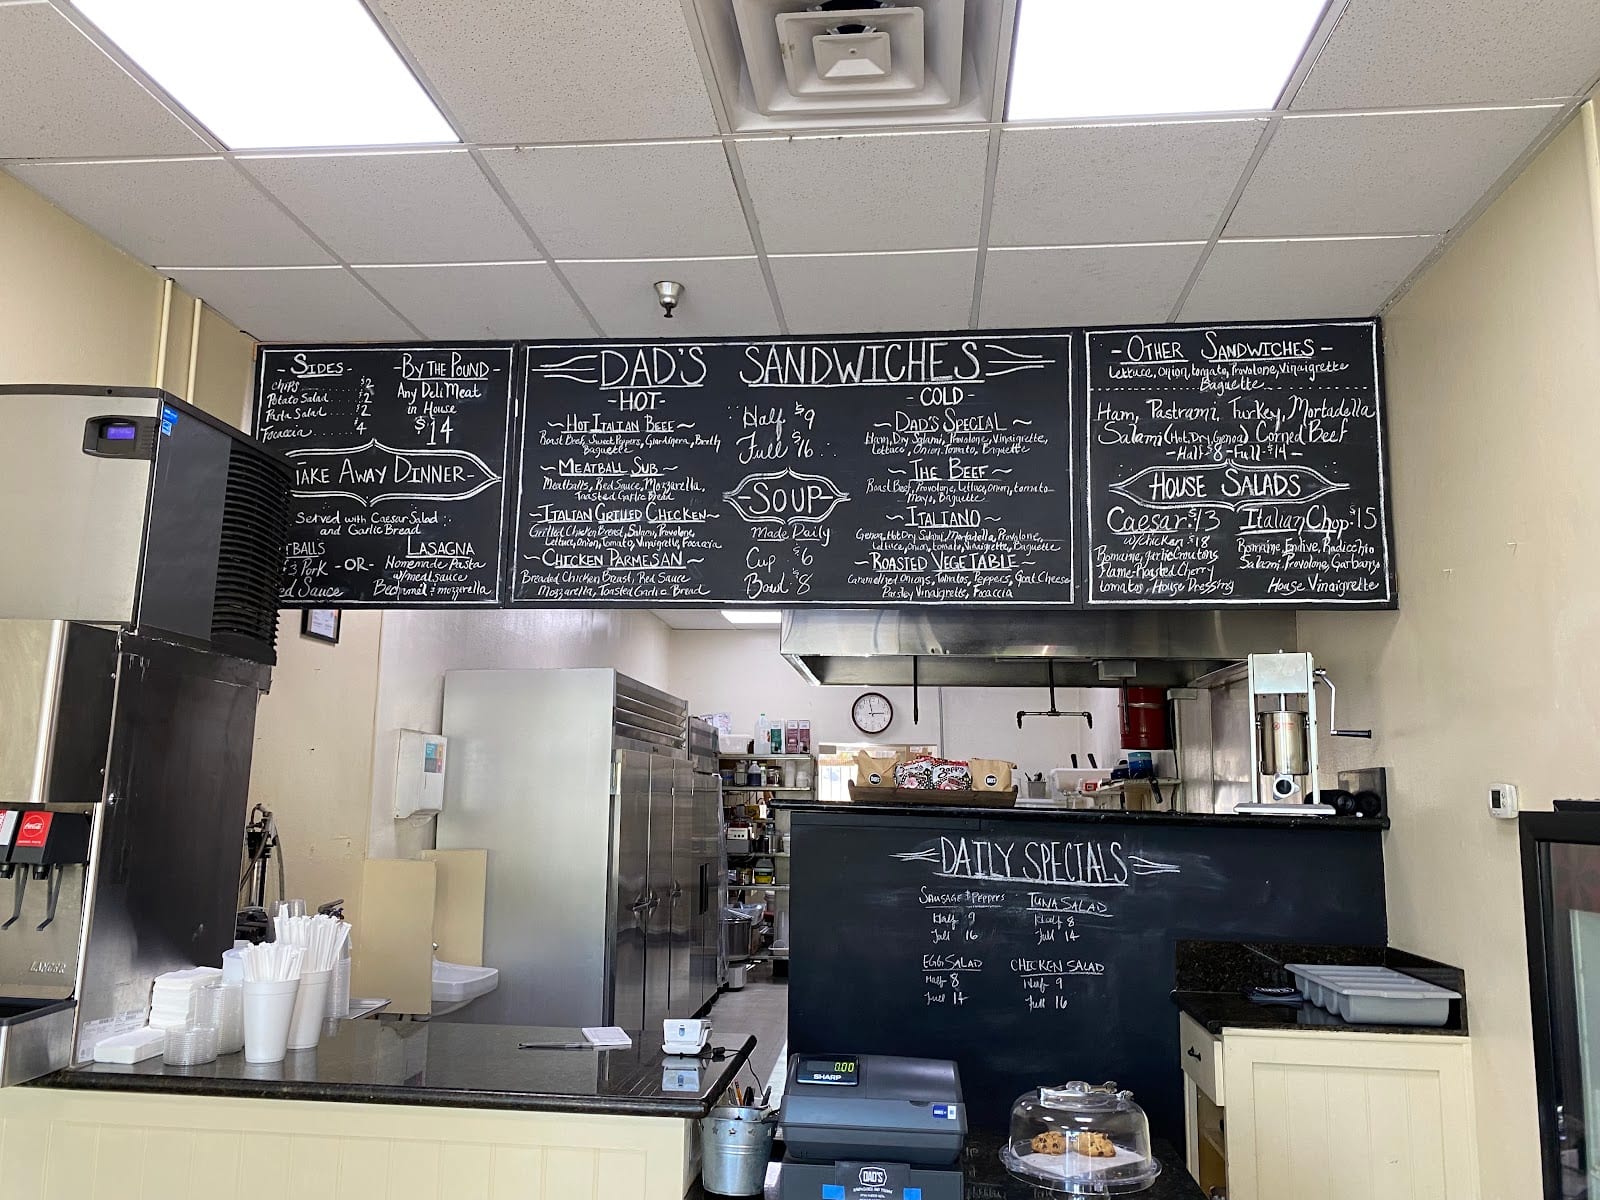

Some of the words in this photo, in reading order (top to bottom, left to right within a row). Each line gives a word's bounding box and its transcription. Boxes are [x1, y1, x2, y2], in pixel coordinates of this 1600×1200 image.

[1127, 335, 1184, 361] OTHER
[1201, 331, 1315, 360] SANDWICHES
[290, 353, 344, 376] SIDES
[427, 360, 447, 377] THE
[451, 351, 489, 377] POUND
[600, 347, 707, 387] DAD'S
[739, 341, 981, 384] SANDWICHES
[360, 376, 374, 390] $2
[397, 381, 418, 404] Any
[421, 382, 444, 399] Deli
[444, 382, 482, 399] Meat
[1200, 378, 1266, 396] Baguette
[266, 393, 299, 408] Potato
[300, 391, 329, 403] Salad
[620, 390, 662, 411] HOT
[920, 387, 964, 405] COLD
[297, 405, 327, 419] Salad
[356, 404, 371, 417] $2
[407, 404, 417, 414] in
[424, 402, 457, 417] House
[1286, 395, 1376, 420] Mortadella
[354, 417, 367, 435] $4
[566, 414, 591, 432] HOT
[591, 413, 640, 432] ITALIAN
[644, 415, 676, 433] BEEF
[743, 404, 787, 441] Half
[794, 400, 816, 430] $9
[895, 411, 940, 432] DAD'S
[943, 407, 1008, 433] SPECIAL
[414, 416, 454, 445] $14
[1255, 420, 1303, 445] Corned
[1309, 419, 1349, 444] Beef
[736, 431, 789, 464] Full
[791, 429, 814, 458] $16
[295, 461, 330, 486] TAKE
[339, 458, 388, 485] AWAY
[394, 455, 467, 483] DINNER
[558, 458, 628, 475] MEATBALL
[630, 456, 659, 475] SUB
[909, 458, 940, 480] THE
[949, 457, 989, 480] BEEF
[1149, 474, 1208, 499] HOUSE
[1222, 467, 1302, 497] SALADS
[749, 482, 823, 514] SOUP
[295, 511, 340, 524] Served
[345, 513, 366, 524] with
[370, 511, 411, 524] Caesar
[410, 511, 438, 524] Salad
[537, 504, 592, 522] ITALIAN
[595, 502, 643, 521] GRILLED
[645, 502, 707, 521] CHICKEN
[904, 506, 981, 528] ITALIANO
[1107, 506, 1188, 534] Caesar
[319, 525, 341, 536] and
[348, 525, 383, 536] Garlic
[383, 524, 422, 536] Bread
[1237, 508, 1304, 535] Italian
[1306, 505, 1350, 540] Chop
[751, 526, 790, 540] Made
[791, 523, 831, 547] Daily
[408, 536, 475, 556] LASAGNA
[301, 557, 329, 577] Pork
[344, 557, 368, 572] OR
[542, 548, 604, 567] CHICKEN
[606, 548, 683, 567] PARMESAN
[746, 546, 777, 573] Cup
[792, 544, 814, 566] $6
[868, 552, 928, 571] ROASTED
[931, 551, 1020, 571] VEGETABLE
[298, 576, 345, 597] Sauce
[562, 570, 600, 584] Chicken
[637, 571, 655, 584] Red
[657, 571, 691, 584] Sauce
[744, 572, 790, 599] Bowl
[792, 567, 814, 595] $8
[1267, 577, 1306, 596] House
[1308, 573, 1380, 597] Vinaigrette
[941, 836, 1015, 880] DAILY
[1023, 841, 1128, 883] SPECIALS
[1027, 892, 1058, 910] TUNA
[1060, 896, 1107, 913] SALAD
[1066, 916, 1075, 927] 8
[965, 930, 978, 941] 16
[1064, 930, 1081, 942] 14
[944, 953, 983, 970] SALAD
[1010, 958, 1063, 973] CHICKEN
[1066, 960, 1105, 972] SALAD
[950, 972, 960, 988] 8
[1055, 977, 1063, 990] 9
[953, 991, 969, 1006] 14
[1055, 995, 1068, 1009] 16
[813, 1073, 842, 1081] SHARP
[862, 1170, 884, 1183] DAD'S
